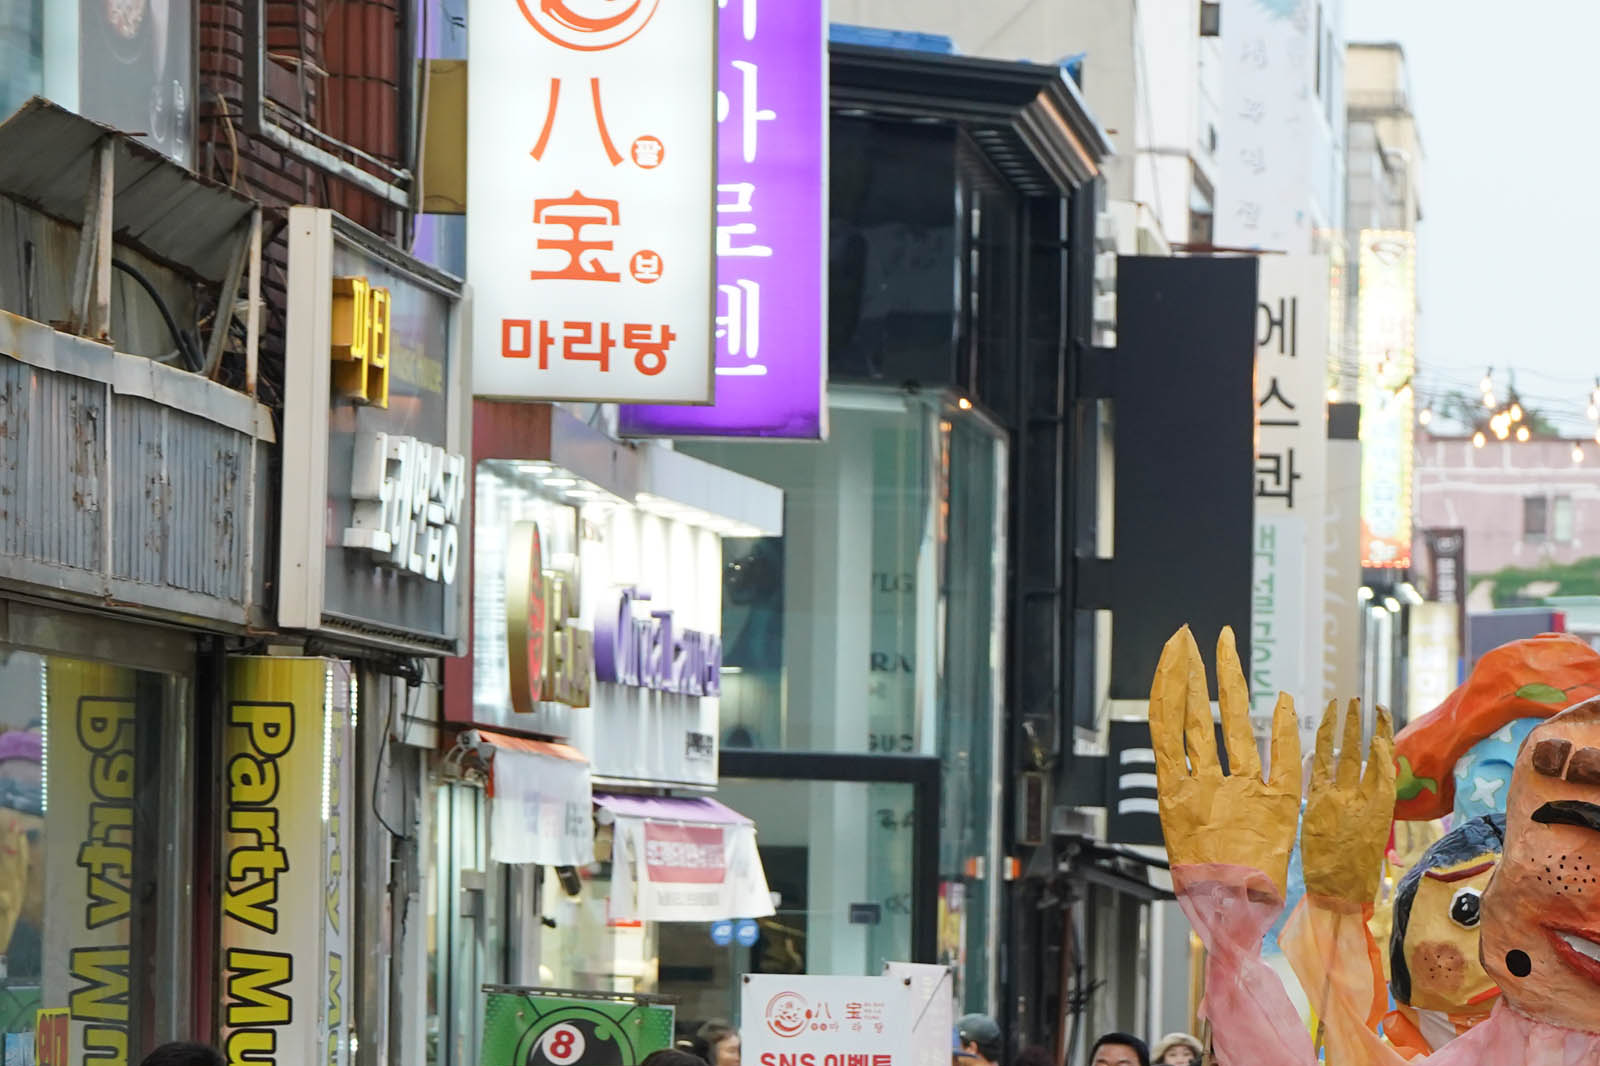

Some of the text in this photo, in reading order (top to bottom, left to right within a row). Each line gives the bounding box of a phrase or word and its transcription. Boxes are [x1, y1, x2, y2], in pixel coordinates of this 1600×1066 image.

[635, 254, 660, 279] 보
[501, 318, 677, 376] 마라탕
[1255, 297, 1302, 508] 에스콰
[227, 701, 294, 934] Party
[550, 1030, 575, 1060] 8
